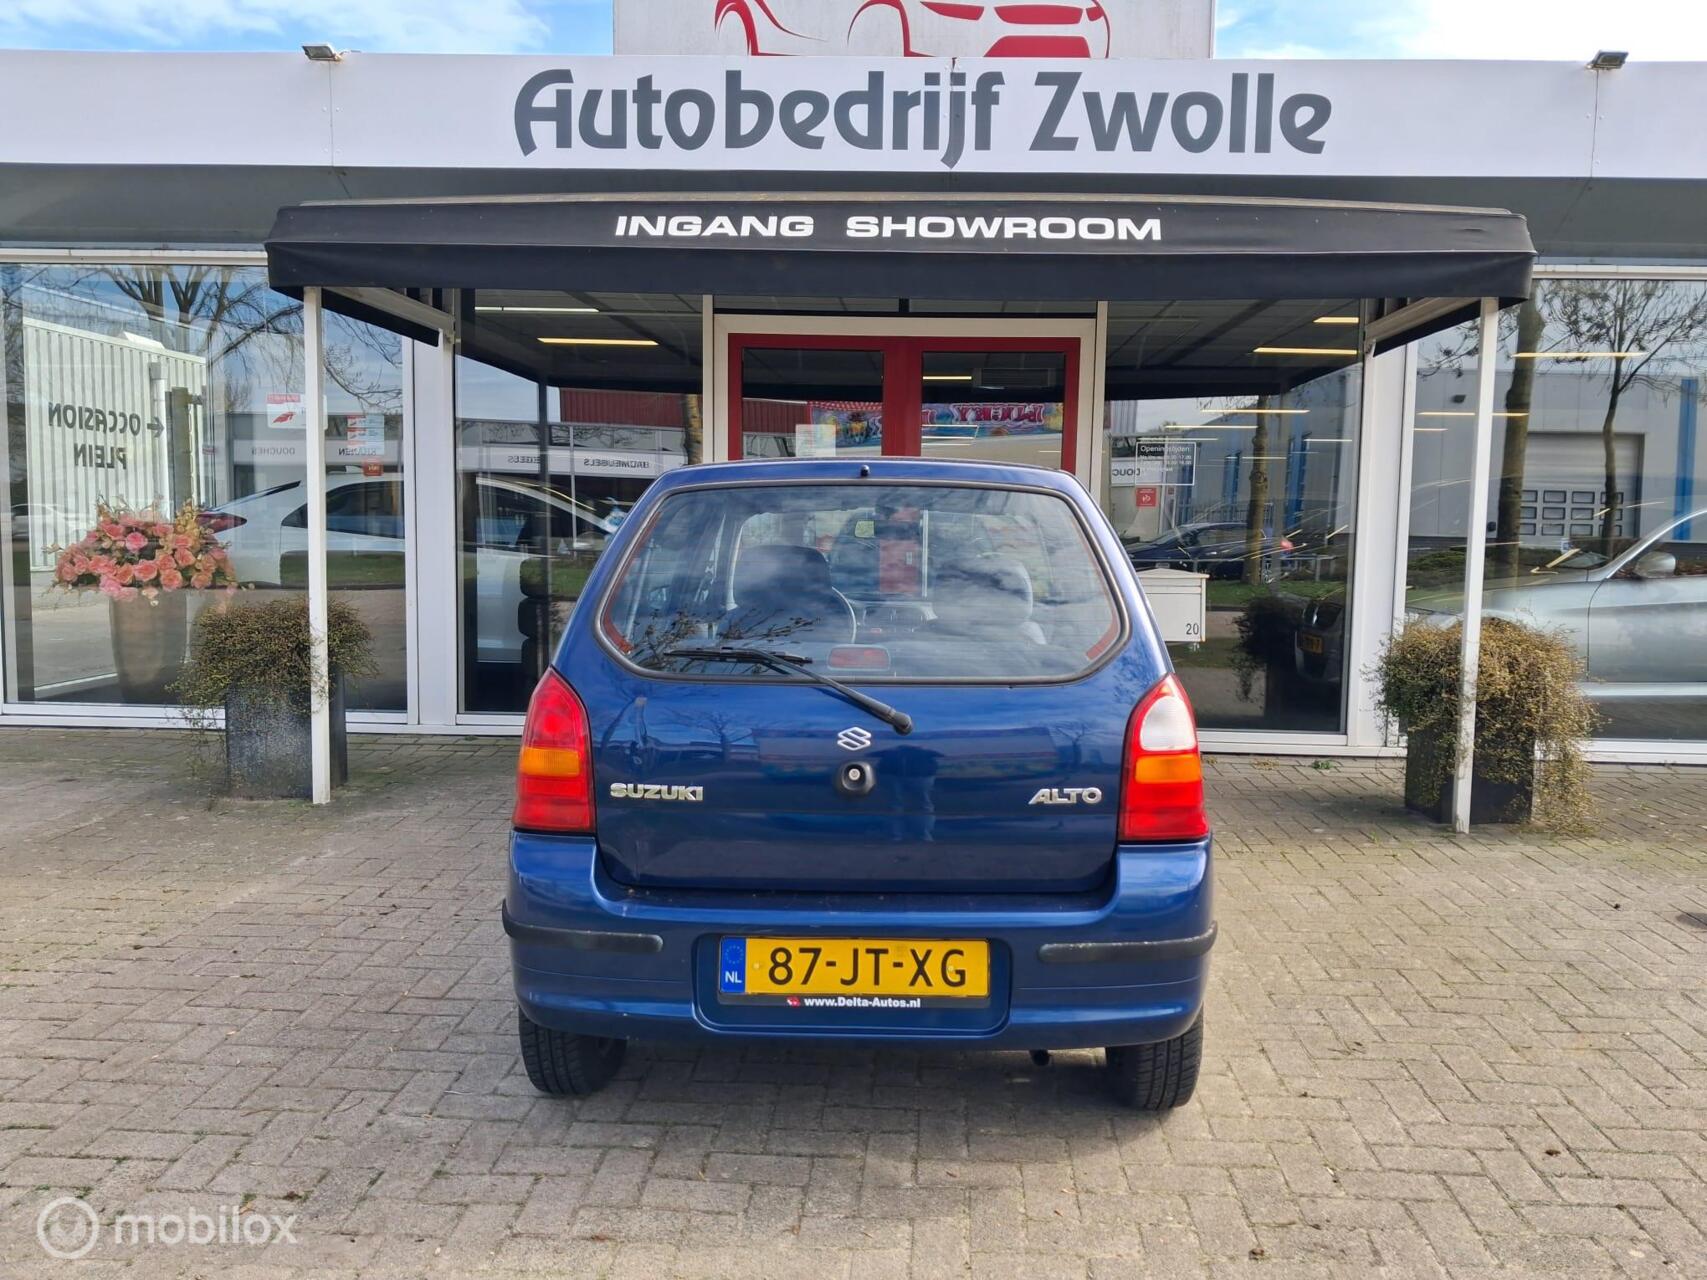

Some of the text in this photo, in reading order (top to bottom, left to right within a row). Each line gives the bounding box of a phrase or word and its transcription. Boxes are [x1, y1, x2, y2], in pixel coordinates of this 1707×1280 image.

[513, 68, 1332, 170] Autobedrijf Zwolle
[615, 215, 1162, 241] INGANG SHOWROOM
[1186, 622, 1200, 635] 20
[610, 782, 704, 801] SUZUKI
[1028, 787, 1102, 804] ALTO
[768, 947, 967, 987] 87-JT-XG
[724, 971, 743, 983] NL
[804, 996, 921, 1008] www.Delta-Autos.nl
